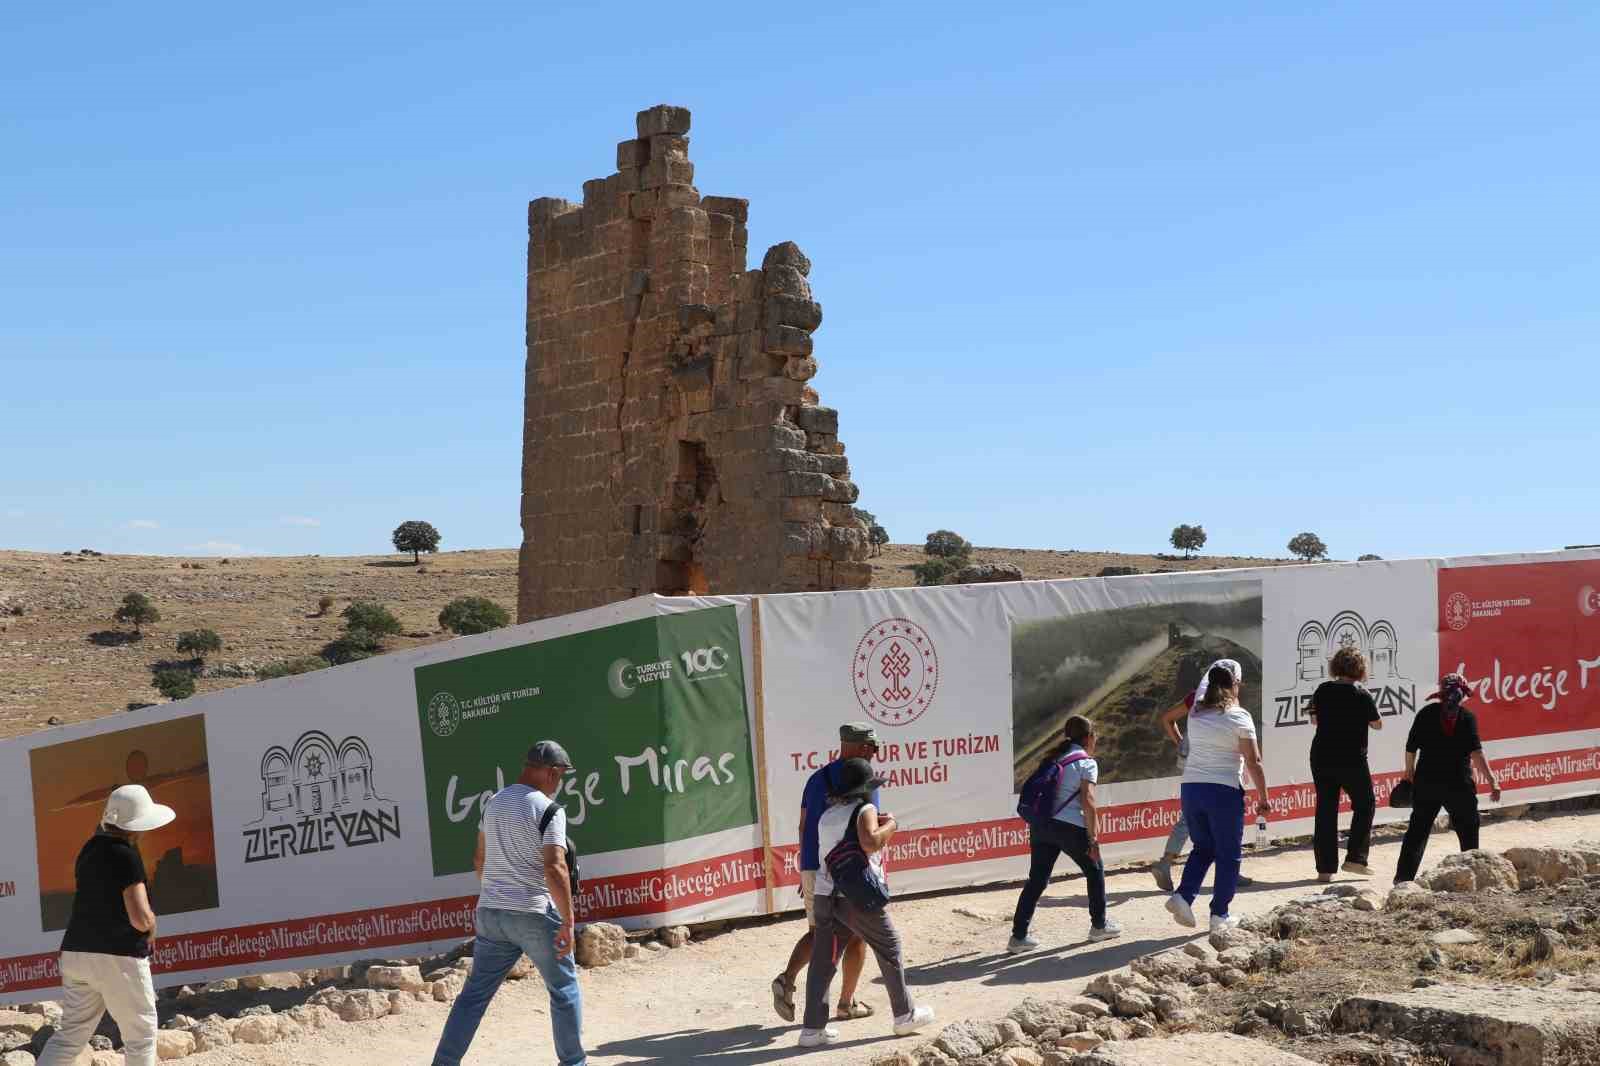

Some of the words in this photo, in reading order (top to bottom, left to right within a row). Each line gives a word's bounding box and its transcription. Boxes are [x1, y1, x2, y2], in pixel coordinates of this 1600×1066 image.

[501, 691, 511, 701] VE
[791, 751, 824, 771] T.C.
[829, 741, 900, 764] KÜR
[905, 741, 928, 760] VE
[933, 733, 1000, 757] TURİZM
[614, 745, 735, 795] Miras
[873, 761, 948, 788] KANLIĞI
